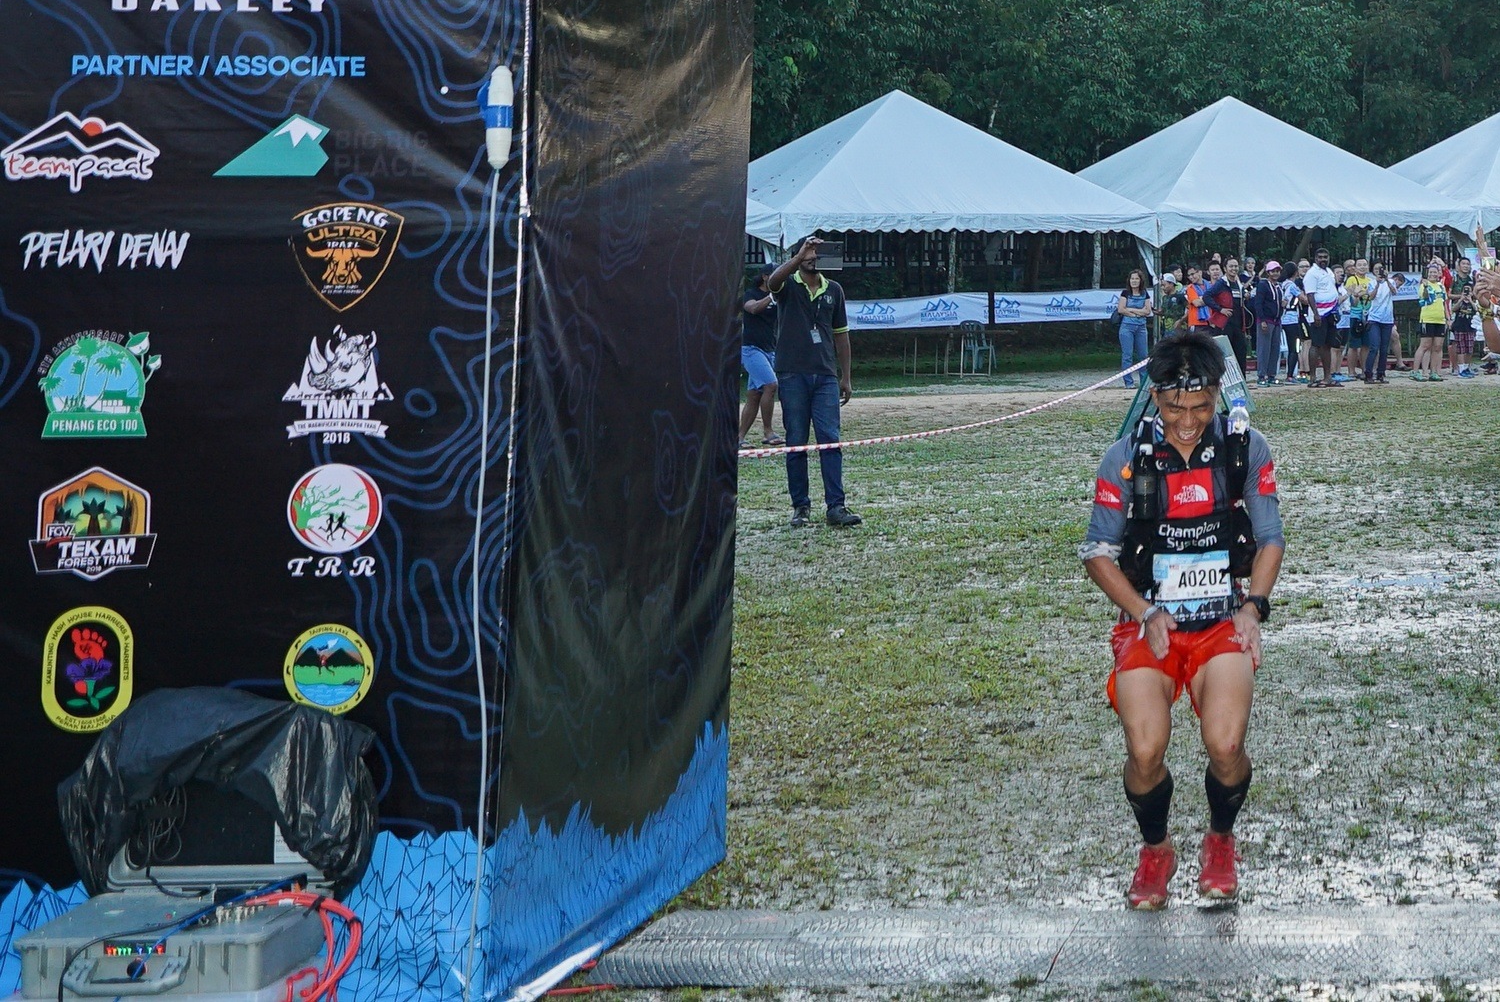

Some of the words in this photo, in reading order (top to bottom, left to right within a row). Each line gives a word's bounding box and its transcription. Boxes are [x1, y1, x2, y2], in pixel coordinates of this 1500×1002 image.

[71, 54, 193, 77] PARTNER
[214, 55, 366, 77] ASSOCIATE
[9, 153, 152, 189] teampacat
[302, 206, 389, 228] GOPENG
[308, 225, 377, 242] ULTRA
[20, 229, 115, 274] PELARI
[117, 228, 190, 270] DENAI
[301, 399, 375, 419] TMMT
[52, 419, 94, 432] PENANG
[96, 419, 117, 431] ECO
[121, 419, 137, 431] 100
[323, 432, 351, 444] 2018
[48, 525, 72, 537] FGV
[1158, 521, 1220, 537] Champion
[58, 538, 136, 558] TEKAM
[57, 557, 101, 569] FOREST
[103, 554, 131, 566] TRAIL
[68, 611, 92, 623] HOUSE
[95, 612, 127, 635] HARRIERS
